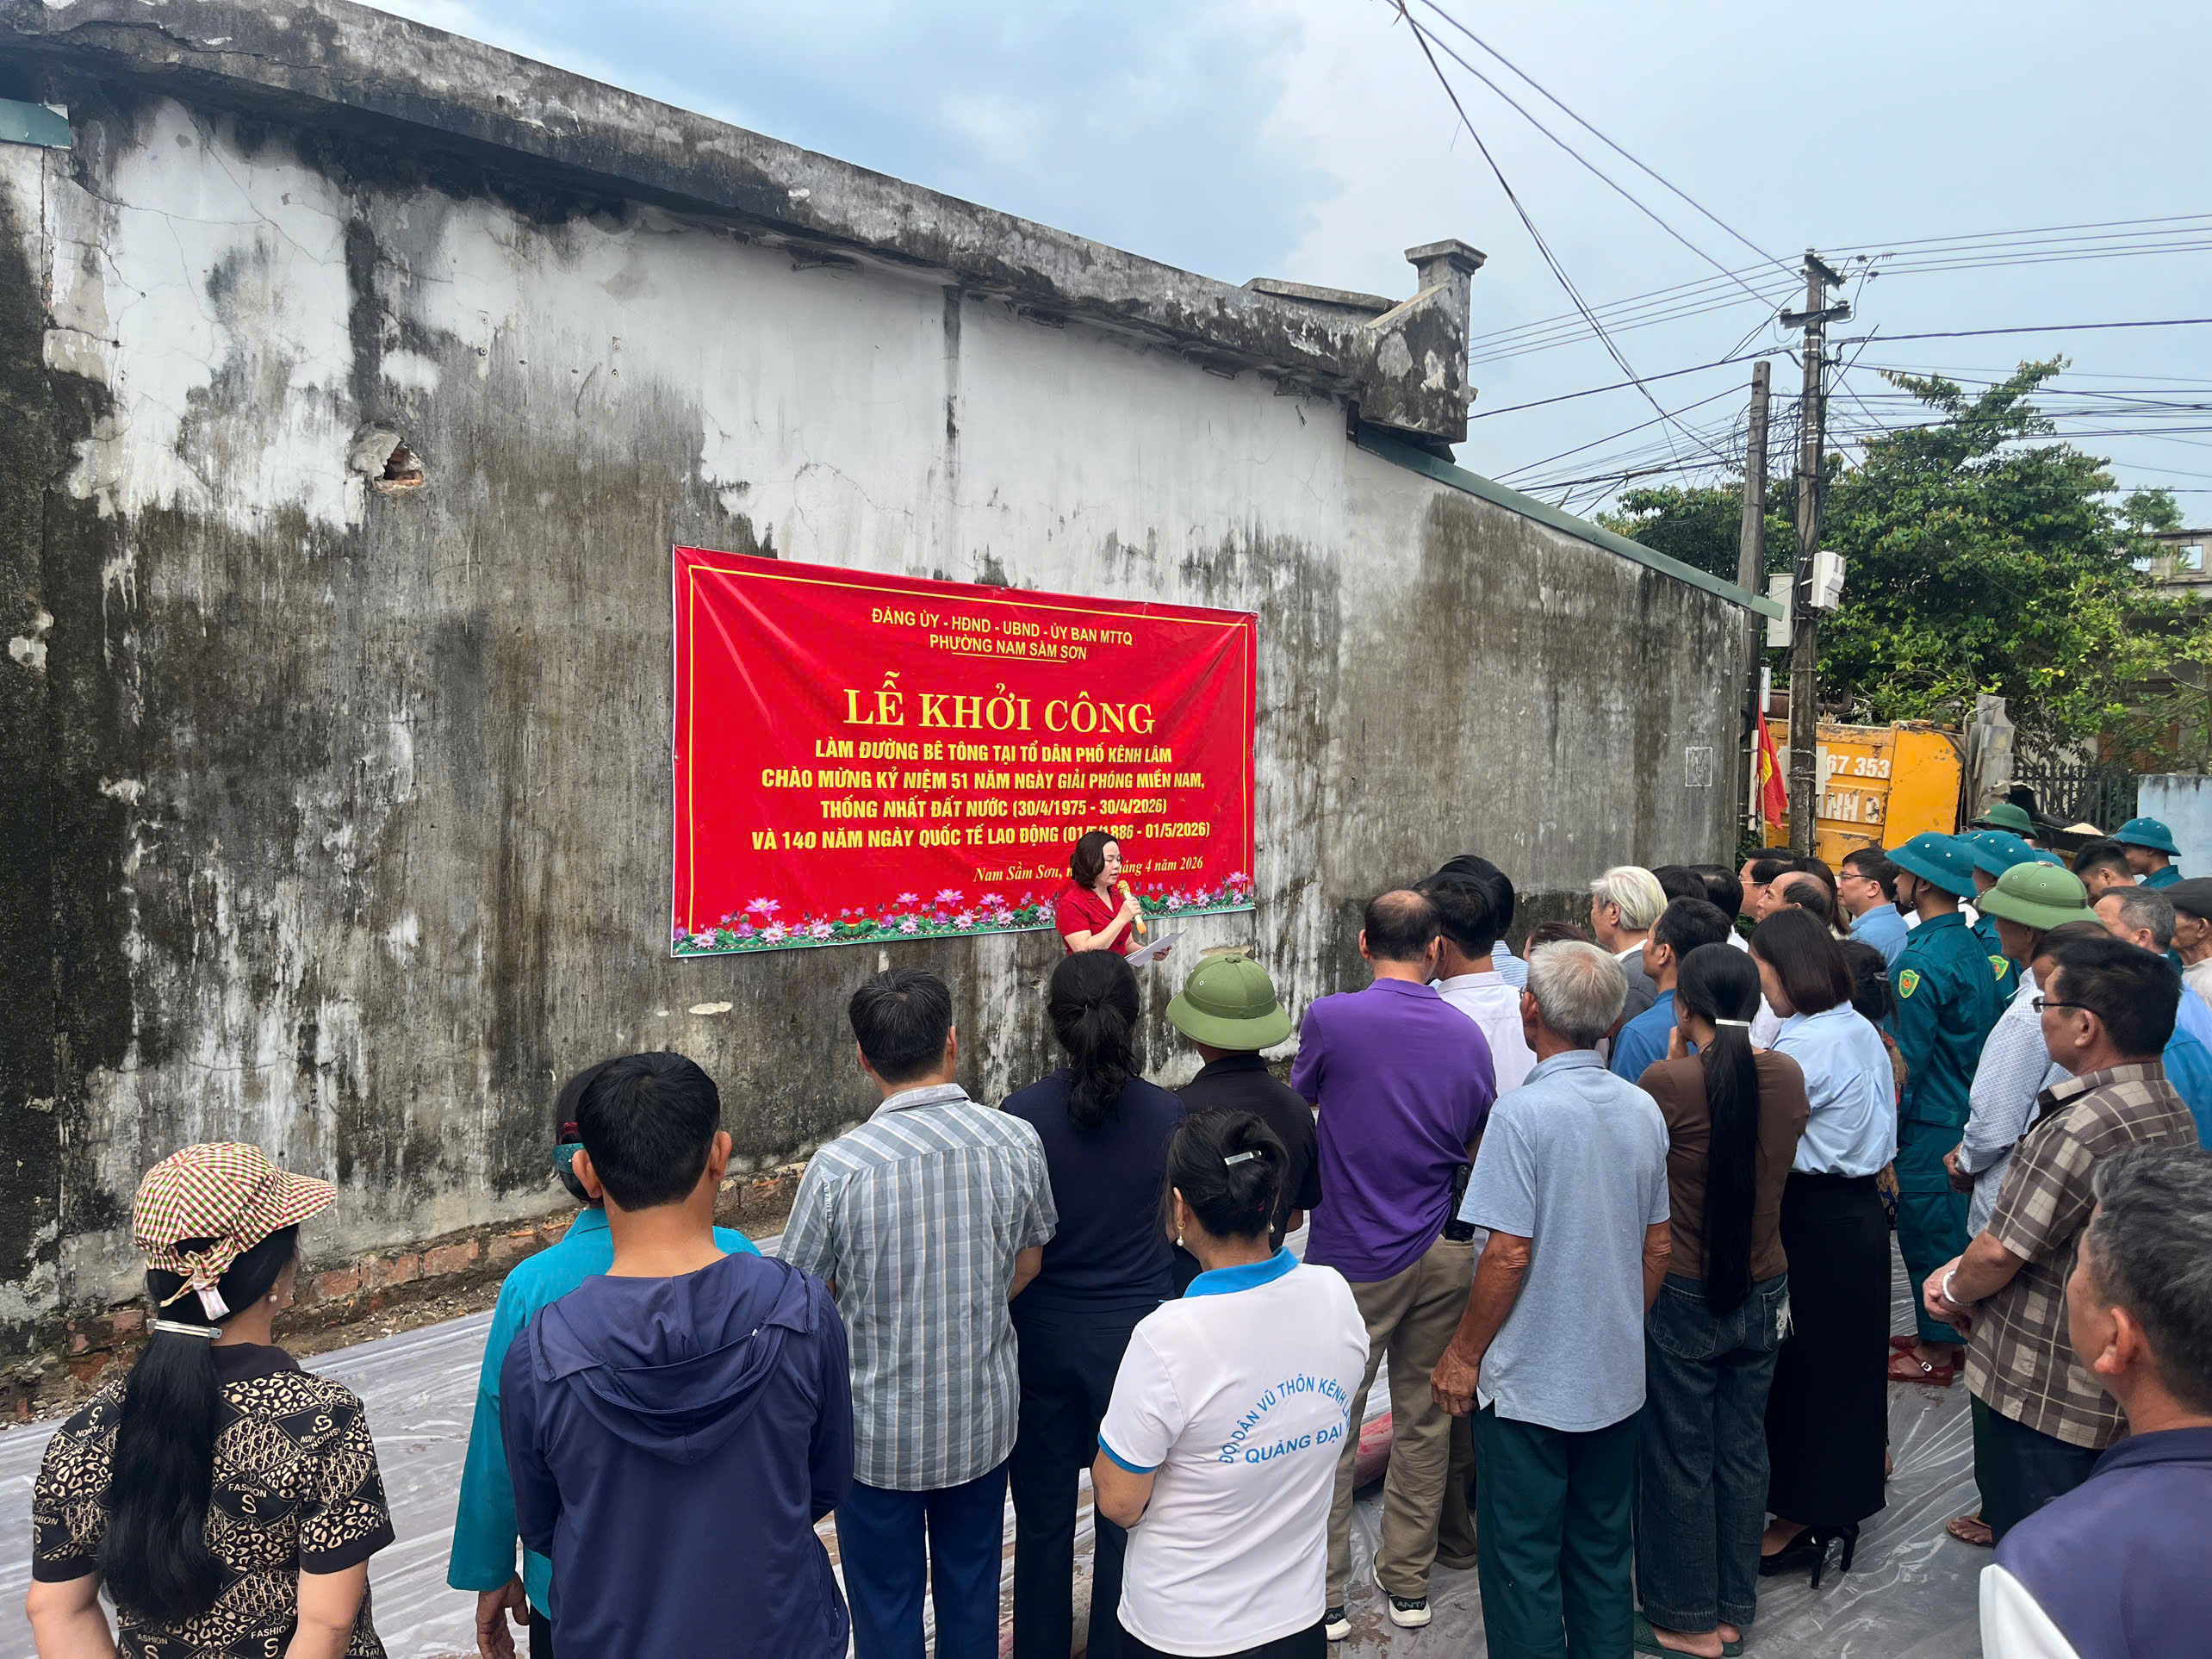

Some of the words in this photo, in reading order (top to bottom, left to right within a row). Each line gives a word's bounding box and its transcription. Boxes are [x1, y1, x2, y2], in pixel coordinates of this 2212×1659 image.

[871, 606, 916, 626] ĐẢNG
[919, 609, 940, 628] ỦY
[952, 616, 991, 633] HĐND
[1003, 620, 1040, 637] UBND
[1050, 622, 1067, 640] ỦY
[1071, 626, 1097, 643] BAN
[1100, 629, 1133, 646] MTTQ
[929, 633, 992, 653] PHƯỜNG
[996, 639, 1026, 656] NAM
[1059, 644, 1087, 660] SƠN
[842, 670, 904, 726] LỄ
[917, 682, 1032, 730] KHỞI
[1043, 691, 1156, 735] CÔNG
[815, 736, 854, 758] LÀM
[859, 738, 919, 760] ĐƯỜNG
[923, 740, 943, 761] BÊ
[948, 741, 988, 761] TÔNG
[992, 744, 1016, 765] TẠI
[1020, 739, 1038, 762] TỔ
[1041, 743, 1072, 763] DÂN
[1076, 742, 1105, 763] PHỐ
[1108, 744, 1142, 763] KÊNH
[1144, 744, 1172, 763] LÂM
[761, 766, 813, 788] CHÀO
[818, 767, 873, 789] MỪNG
[876, 766, 898, 789] KỶ
[903, 768, 947, 792] NIỆM
[951, 773, 968, 789] 51
[974, 769, 1010, 790] NĂM
[1014, 770, 1053, 790] NGÀY
[1057, 768, 1085, 789] GIẢI
[1089, 771, 1133, 789] PHÓNG
[1136, 768, 1171, 788] MIỀN
[1173, 773, 1205, 790] NAM,
[1854, 757, 1892, 779] 353
[820, 794, 878, 818] THỐNG
[883, 795, 927, 818] NHẤT
[930, 795, 962, 817] ĐẤT
[966, 797, 1008, 817] NƯỚC
[1013, 799, 1087, 817] (30/4/1975
[1099, 798, 1167, 815] 30/4/2026)
[751, 828, 777, 850] VÀ
[782, 831, 817, 849] 140
[822, 828, 862, 848] NĂM
[867, 827, 915, 848] NGÀY
[918, 823, 961, 848] QUỐC
[966, 823, 985, 845] TẾ
[988, 827, 1016, 845] LAO
[1019, 823, 1059, 847] ĐỘNG
[1145, 822, 1210, 839] 01/5/2026)
[973, 867, 1003, 882] Nam
[1006, 861, 1033, 880] Sầm
[1035, 864, 1064, 880] Sơn,
[1144, 857, 1152, 871] 4
[1154, 856, 1177, 871] năm
[1179, 855, 1203, 870] 2026
[1231, 1410, 1260, 1441] DÂN
[1257, 1389, 1277, 1412] VŨ
[1277, 1373, 1314, 1398] THÔN
[1318, 1378, 1347, 1407] KÊNH
[1246, 1434, 1311, 1463] QUẢNG
[1315, 1423, 1343, 1445] ĐẠI
[241, 1494, 257, 1513] S
[251, 1625, 289, 1639] FASHIO
[264, 1637, 279, 1658] S
